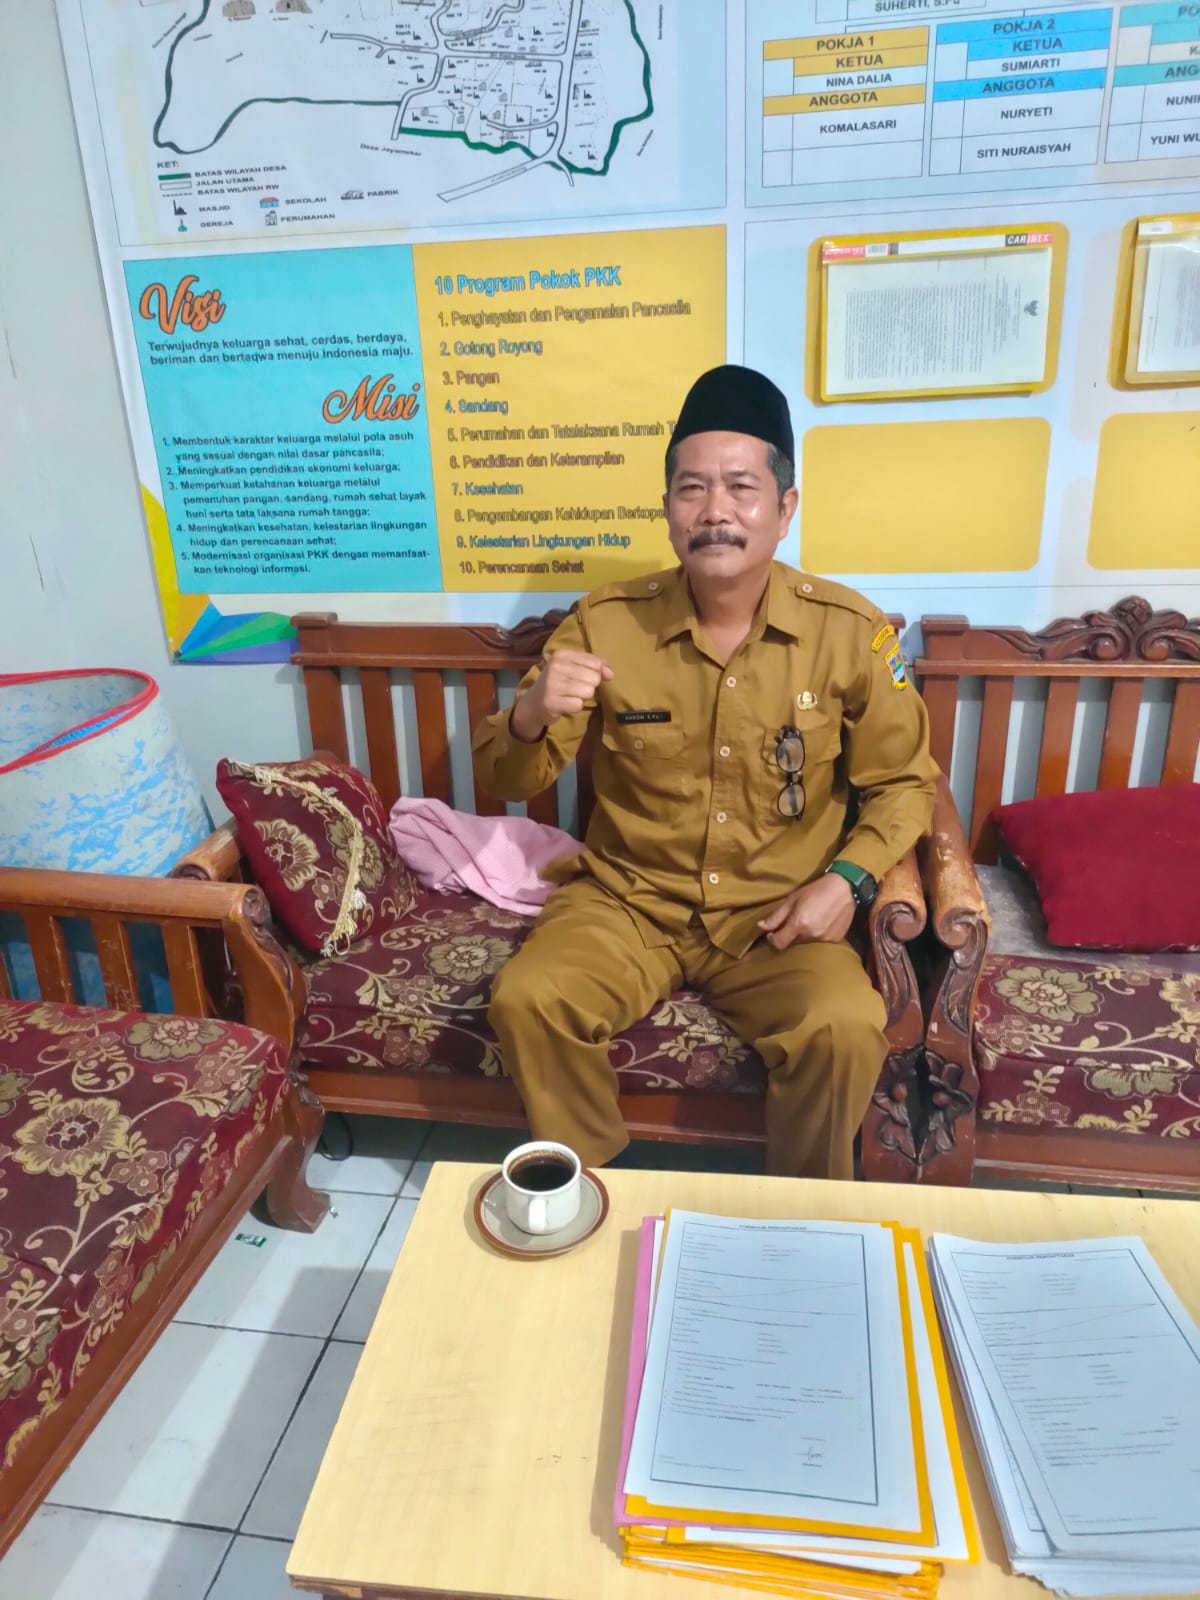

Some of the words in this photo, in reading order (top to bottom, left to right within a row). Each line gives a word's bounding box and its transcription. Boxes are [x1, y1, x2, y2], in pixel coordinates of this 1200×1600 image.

[993, 21, 1043, 34] POKJA
[1046, 19, 1055, 30] 2
[816, 38, 863, 51] POKJA
[869, 37, 875, 47] 1
[1012, 38, 1062, 52] KETUA
[836, 54, 884, 68] KETUA
[1001, 58, 1060, 72] SUMIARTI
[1165, 66, 1200, 78] ANG
[826, 76, 856, 87] NINA
[859, 74, 892, 85] DALIA
[982, 78, 1055, 93] ANGGOTA
[809, 93, 878, 107] ANGGOTA
[1000, 107, 1052, 119] NURYETI
[819, 120, 897, 133] KOMALASARI
[1151, 135, 1180, 145] YUNI
[977, 148, 999, 158] SITI
[1002, 143, 1071, 157] NURAISYAH
[157, 161, 179, 169] KET:
[224, 167, 261, 176] WILAYAH
[227, 186, 263, 194] WILAYAH
[281, 214, 335, 222] PERUMAHAN
[1008, 233, 1049, 244] CARINEX
[435, 276, 452, 294] 10
[458, 274, 524, 297] Program
[529, 270, 580, 290] Pokok
[585, 266, 621, 287] PKK
[139, 274, 226, 335] Visi
[439, 312, 448, 327] 1.
[451, 308, 527, 328] Penghayatan
[530, 307, 551, 322] dan
[554, 303, 629, 324] Pengamalan
[632, 299, 691, 317] Pancasila
[148, 340, 219, 352] Terwujudnya
[222, 338, 270, 350] keluarga
[274, 336, 308, 347] sehat,
[312, 335, 353, 345] cerdas,
[441, 342, 450, 356] 2.
[454, 340, 496, 358] Gotong
[498, 339, 543, 357] Royong
[150, 354, 196, 365] beriman
[200, 353, 219, 362] dan
[223, 352, 274, 363] bertaqwa
[277, 350, 319, 360] menuju
[322, 348, 378, 358] Indonesia
[382, 347, 413, 357] maju.
[443, 371, 453, 385] 3.
[456, 371, 499, 387] Pangan
[322, 374, 420, 424] Misi
[445, 400, 455, 413] 4.
[459, 399, 508, 415] Sandang
[162, 438, 170, 446] 1.
[173, 436, 231, 446] Membentuk
[234, 435, 274, 444] karakter
[277, 434, 321, 445] keluarga
[324, 433, 360, 442] melalui
[364, 432, 385, 443] pola
[389, 432, 413, 441] asuh
[448, 429, 458, 442] 5.
[461, 426, 525, 441] Perumahan
[528, 427, 549, 440] dan
[552, 424, 619, 438] Tatalaksana
[622, 422, 664, 436] Rumah
[176, 453, 200, 463] yang
[203, 451, 235, 460] sesuai
[238, 450, 274, 462] dengan
[278, 449, 299, 458] nilai
[302, 449, 329, 458] dasar
[450, 456, 460, 469] 6.
[463, 454, 524, 468] Pendidikan
[527, 453, 547, 467] dan
[550, 451, 624, 469] Keterampilan
[166, 467, 175, 475] 2.
[178, 465, 247, 476] Meningkatkan
[250, 464, 304, 475] pendidikan
[308, 464, 350, 472] ekonomi
[169, 482, 178, 490] 3.
[181, 480, 240, 492] Memperkuat
[244, 479, 295, 488] ketahanan
[298, 479, 341, 489] keluarga
[344, 478, 380, 487] melalui
[452, 483, 462, 496] 7.
[465, 482, 523, 495] Kesehatan
[184, 494, 240, 506] pemenuhan
[334, 493, 366, 502] rumah
[369, 492, 396, 501] sehat
[400, 491, 425, 502] layak
[186, 509, 207, 518] huni
[210, 509, 233, 517] serta
[236, 509, 255, 517] tata
[258, 508, 295, 517] laksana
[298, 508, 330, 516] rumah
[455, 509, 464, 522] 8.
[468, 508, 553, 525] Pengembangan
[556, 506, 614, 523] Kehidupan
[176, 524, 185, 532] 4.
[188, 522, 255, 534] Meningkatkan
[314, 521, 368, 530] kelestarian
[371, 520, 426, 531] lingkungan
[190, 537, 217, 548] hidup
[220, 537, 238, 546] dan
[241, 536, 304, 548] perencanaan
[456, 536, 466, 548] 9.
[469, 535, 529, 548] Kelestarian
[532, 534, 594, 550] Lingkungan
[598, 533, 630, 547] Hidup
[182, 552, 189, 561] 5.
[192, 550, 250, 560] Modernisasi
[254, 550, 304, 561] organisasi
[307, 550, 329, 559] PKK
[332, 549, 368, 560] dengan
[194, 565, 211, 574] kan
[214, 564, 259, 576] teknologi
[262, 563, 310, 573] informasi.
[460, 562, 475, 574] 10.
[478, 561, 550, 574] Perencanaan
[552, 560, 584, 573] Sehat
